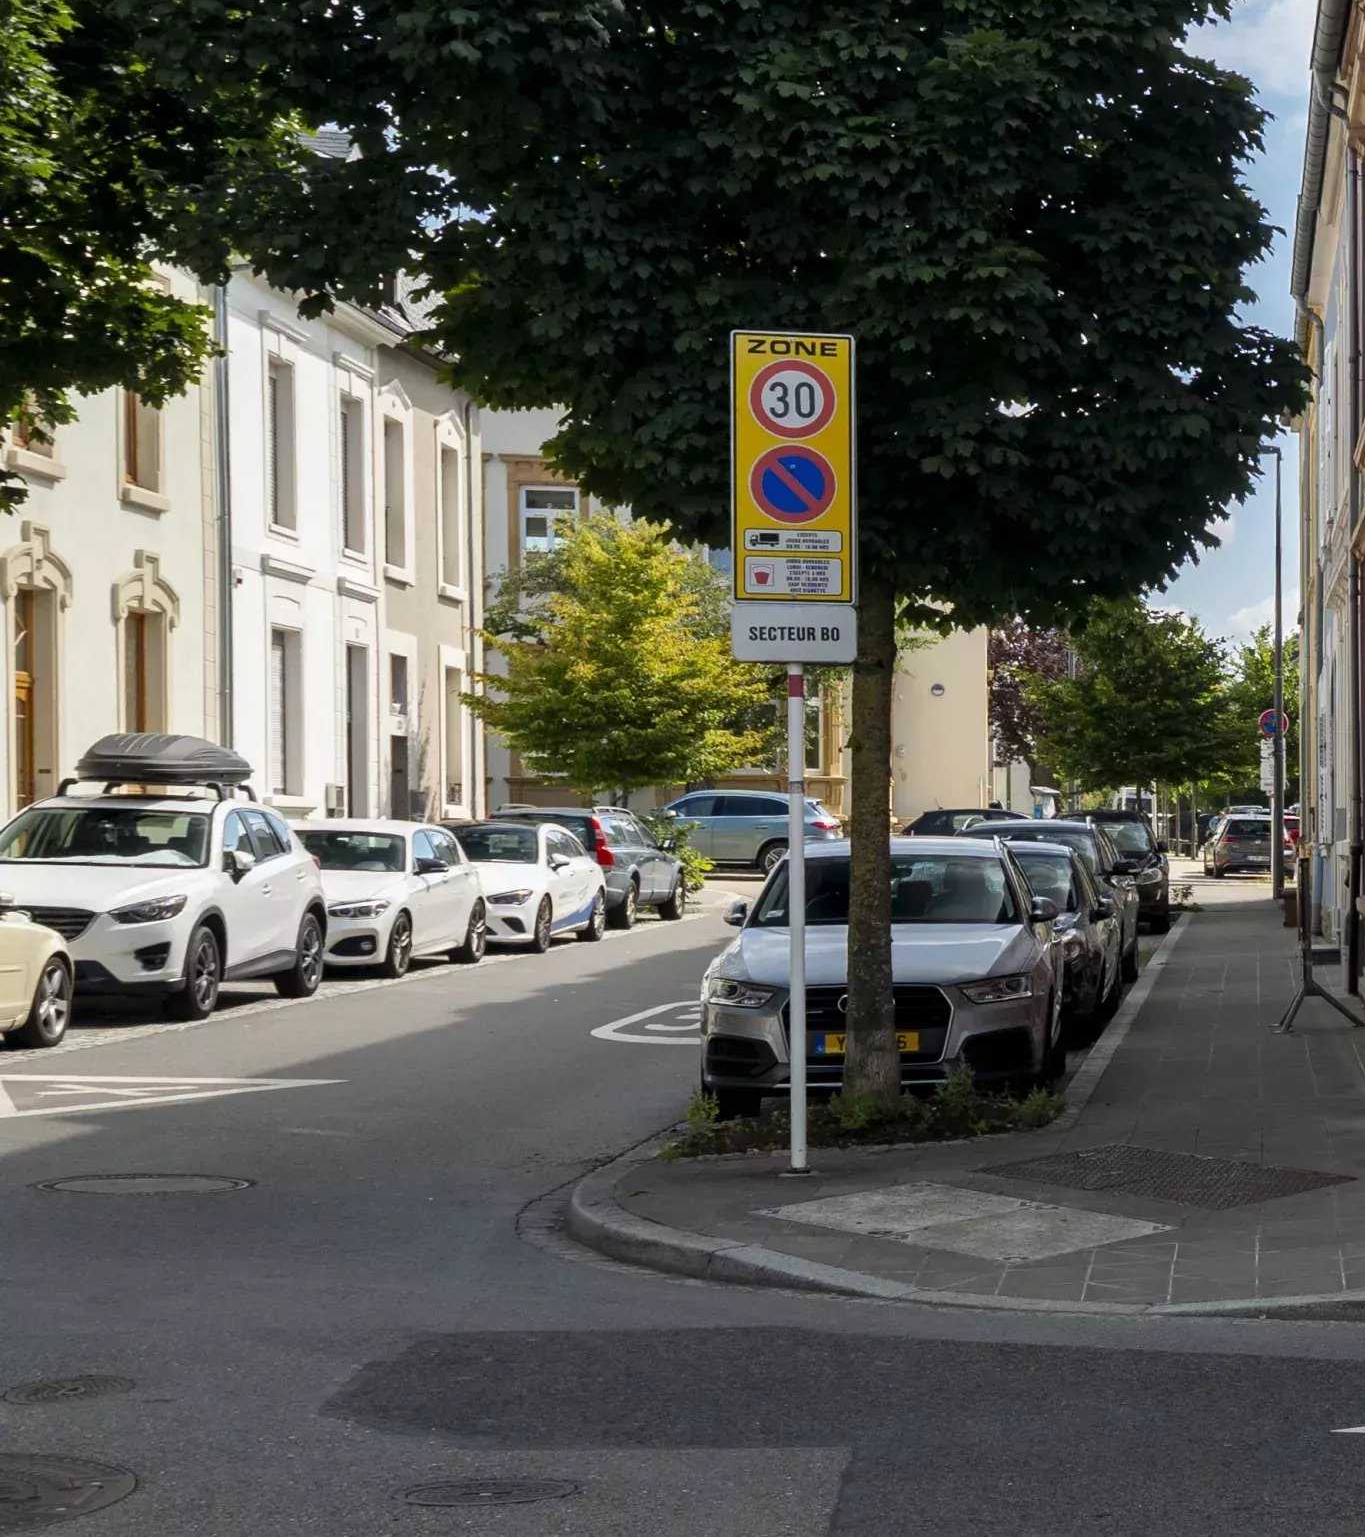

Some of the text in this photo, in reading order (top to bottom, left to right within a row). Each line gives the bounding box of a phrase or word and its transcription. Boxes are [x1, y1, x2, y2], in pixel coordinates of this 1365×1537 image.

[747, 339, 838, 357] ZONE
[769, 381, 816, 419] 30
[748, 626, 840, 642] SECTEUR BO
